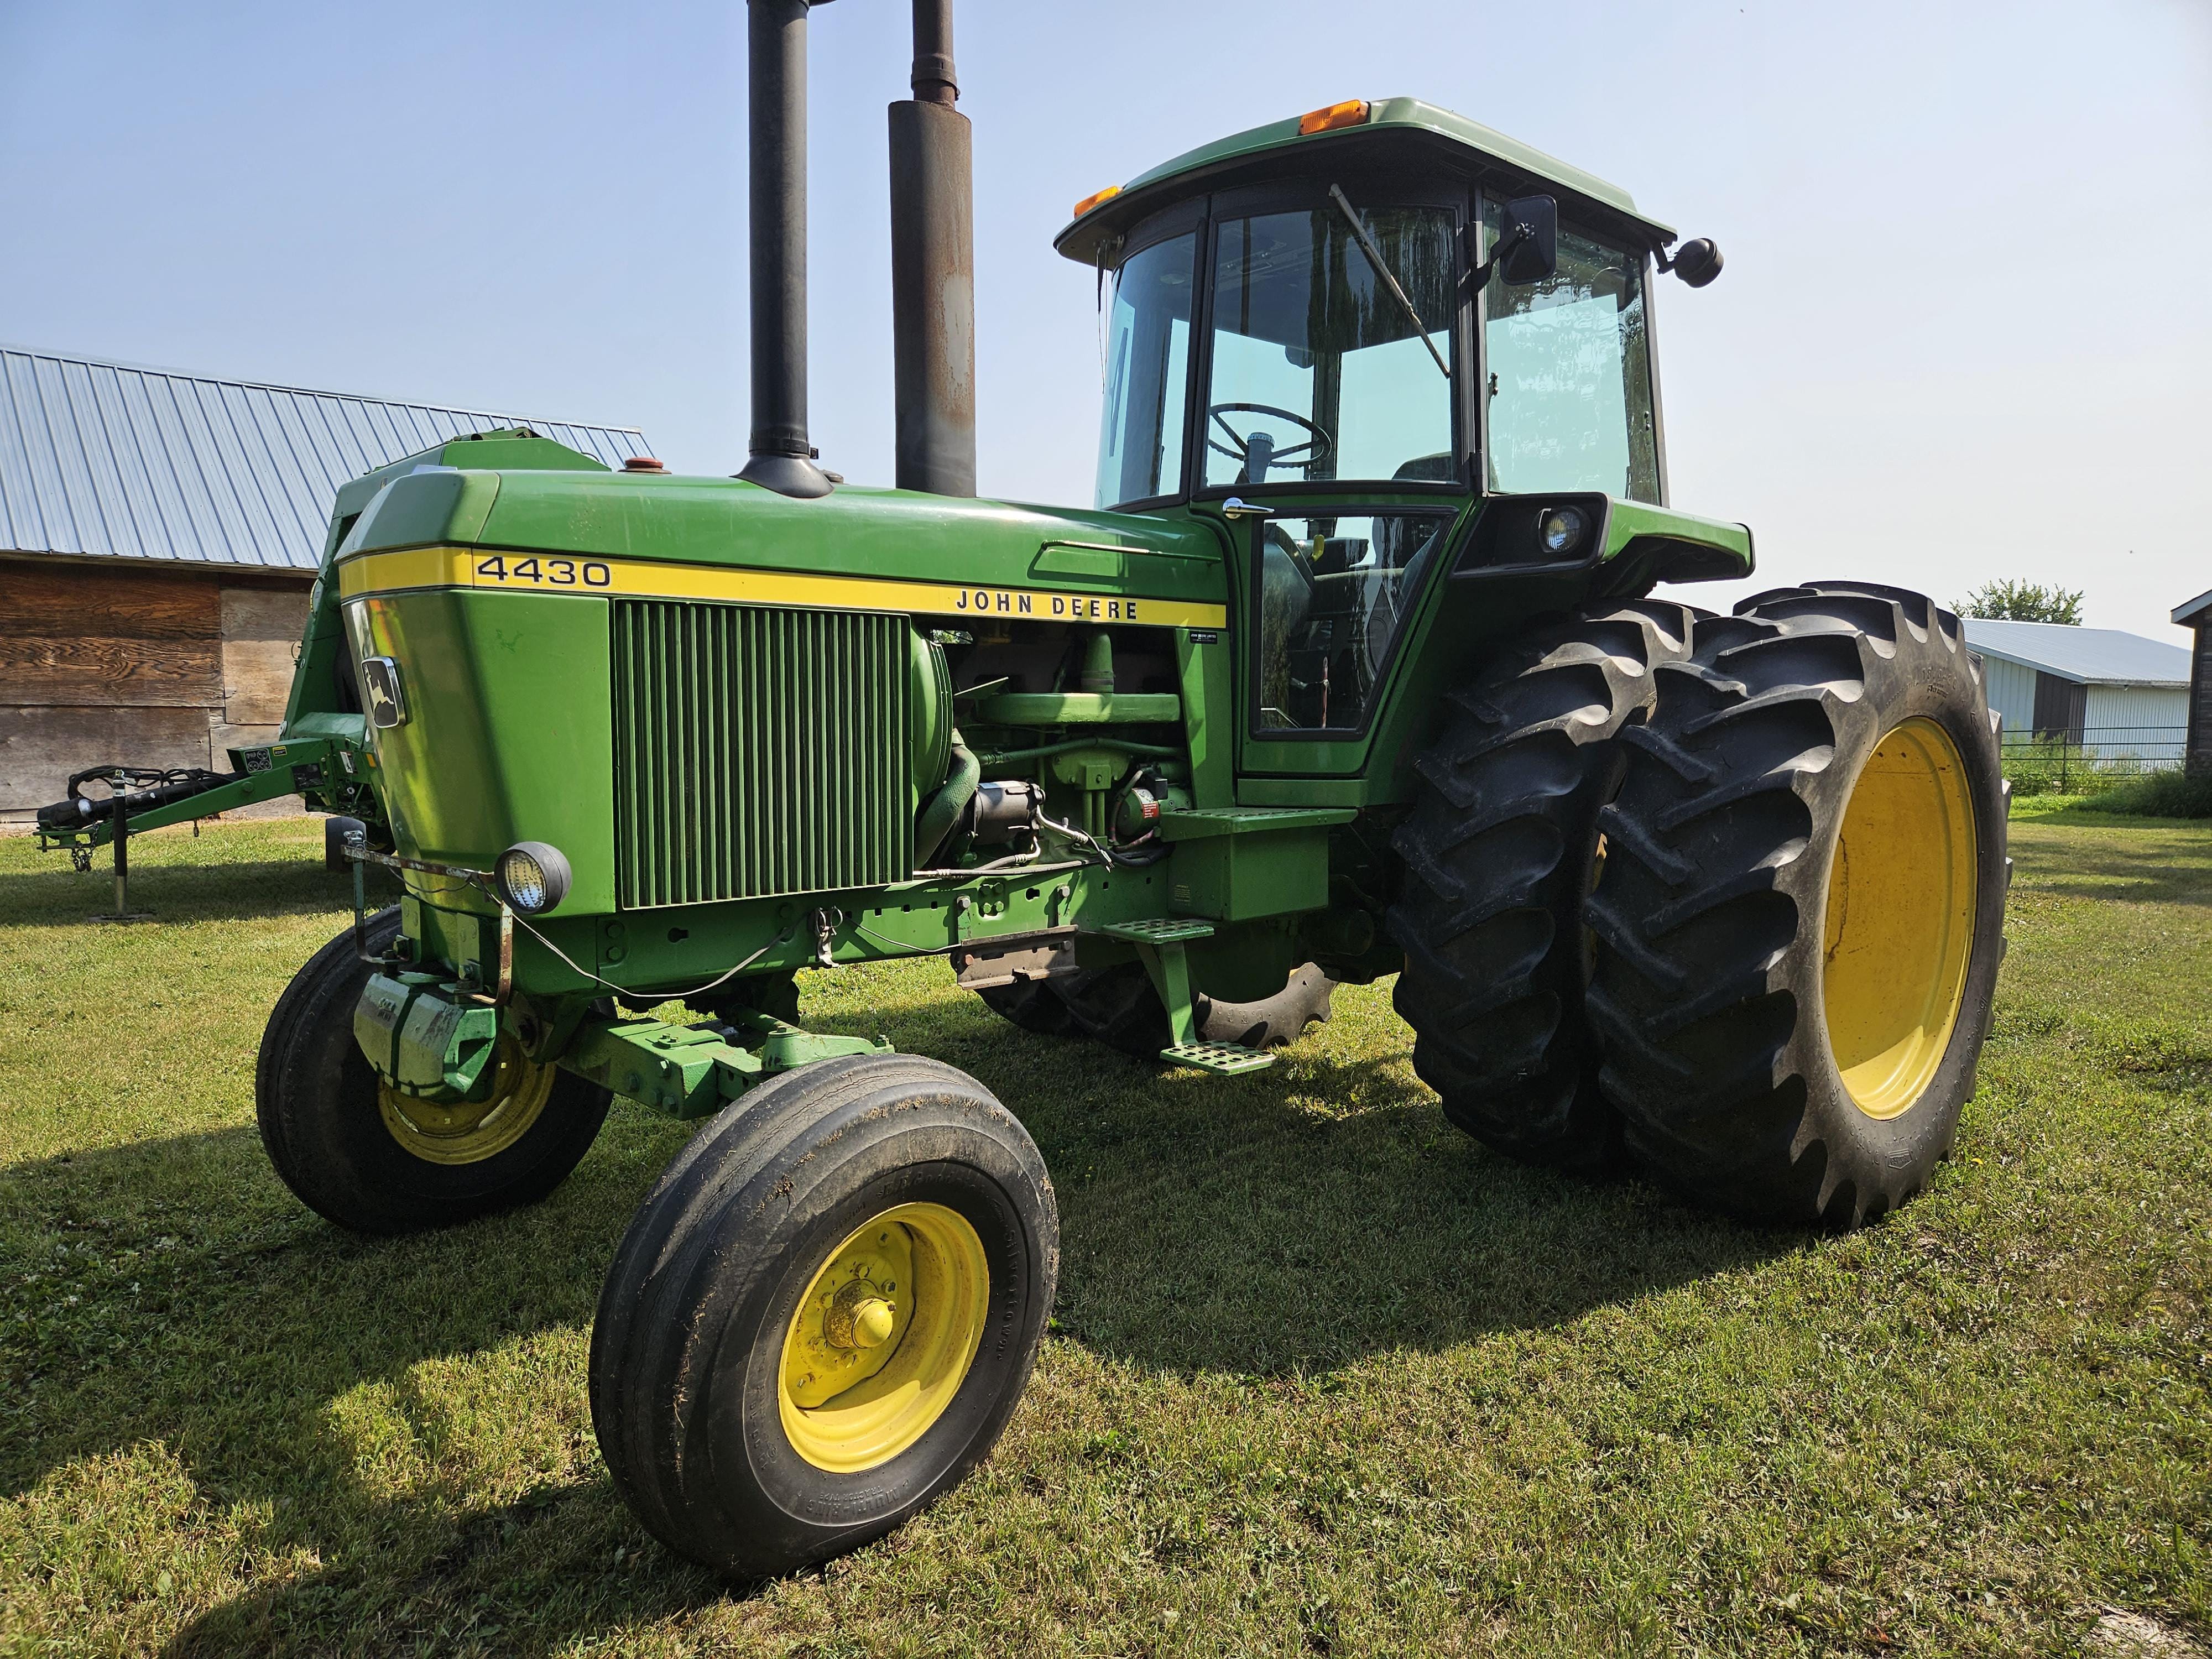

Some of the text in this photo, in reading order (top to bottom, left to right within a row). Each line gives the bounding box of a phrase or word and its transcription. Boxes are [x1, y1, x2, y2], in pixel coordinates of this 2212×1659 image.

[477, 556, 611, 587] 4430
[956, 589, 1137, 620] JOHN DEERE
[818, 1492, 841, 1501] TYPE
